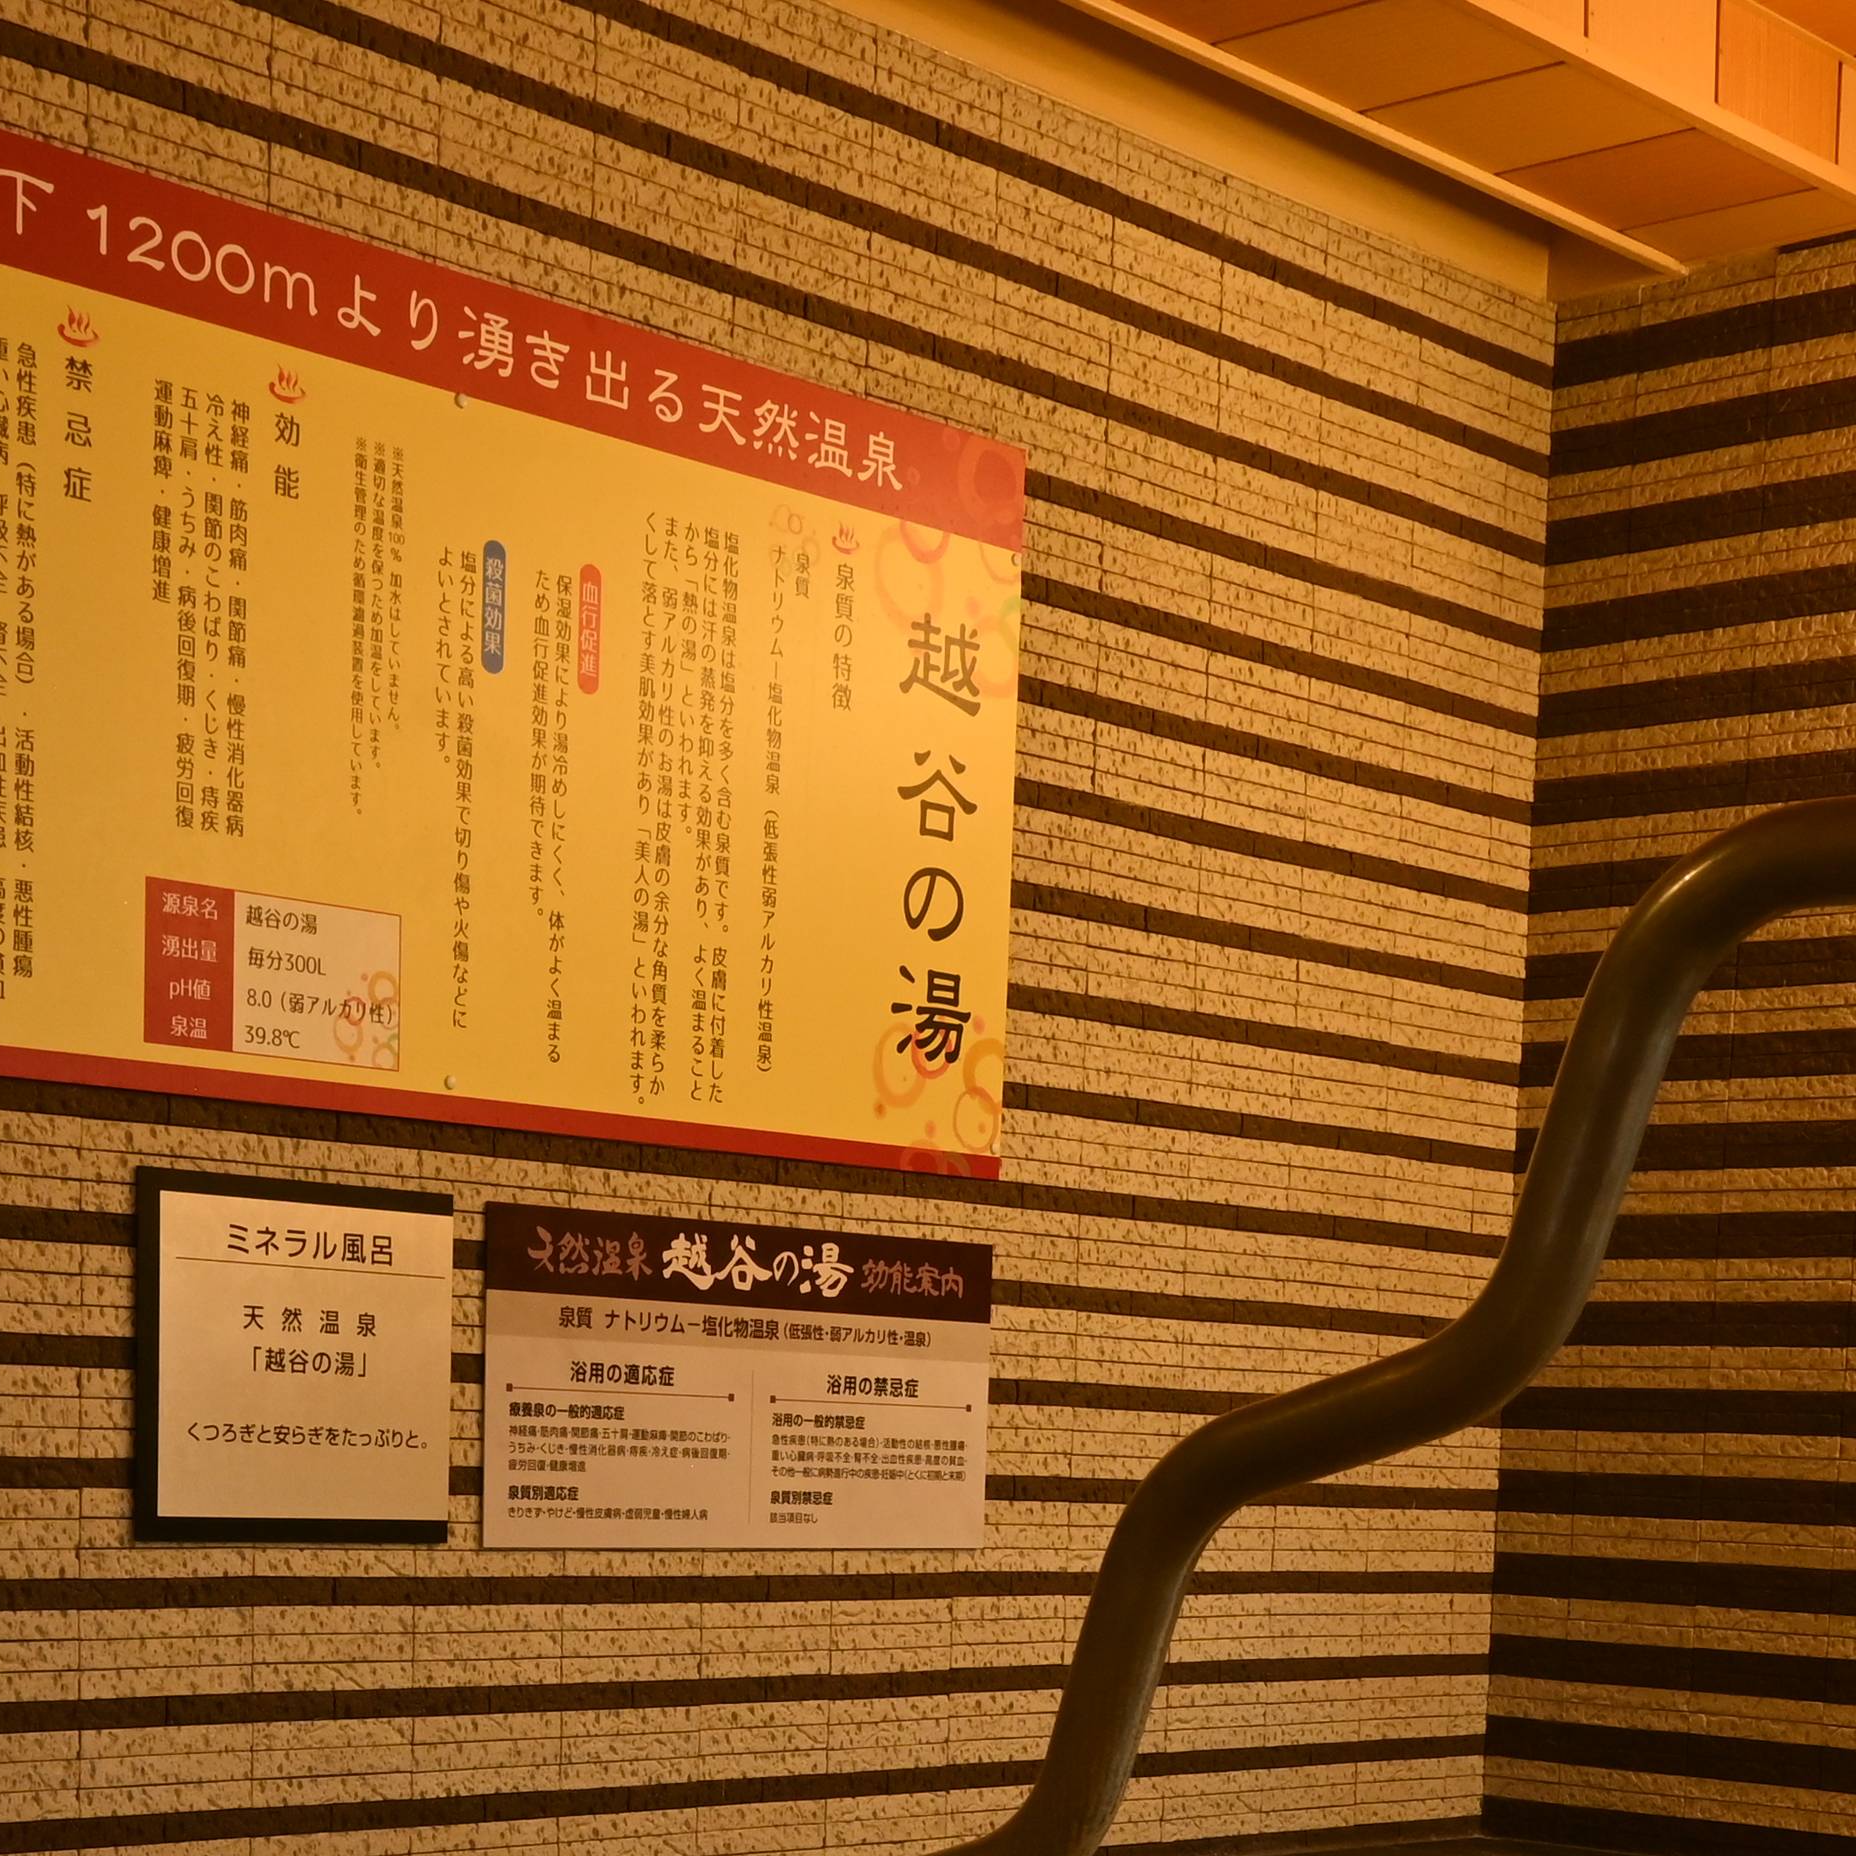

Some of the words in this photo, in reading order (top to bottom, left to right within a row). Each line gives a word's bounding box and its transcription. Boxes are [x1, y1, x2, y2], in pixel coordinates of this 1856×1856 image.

[63, 355, 94, 503] 禁忌症
[273, 411, 301, 500] 効能
[795, 552, 811, 600] 泉質
[483, 557, 504, 656] 殺菌効果
[580, 581, 600, 678] 血行促進
[831, 562, 856, 713] 泉質の特徴
[434, 546, 454, 765] よいとされています。
[890, 611, 982, 1064] 越谷の湯
[161, 890, 219, 921] 源泉名
[245, 903, 318, 935] 越谷の湯
[161, 934, 218, 964] 湧出量
[247, 945, 327, 976] 毎分300L
[169, 977, 212, 1001] pH値
[170, 1014, 208, 1040] 泉温
[244, 1024, 301, 1050] 39.8℃
[226, 1223, 394, 1267] ミネラル風呂
[242, 1304, 377, 1338] 天然温泉
[251, 1346, 368, 1378] 「越谷の湯」
[570, 1360, 676, 1387] 浴用の適応症
[826, 1373, 920, 1399] 浴用の禁忌症
[187, 1422, 428, 1450] くつろぎと安らぎをたっぷりと。
